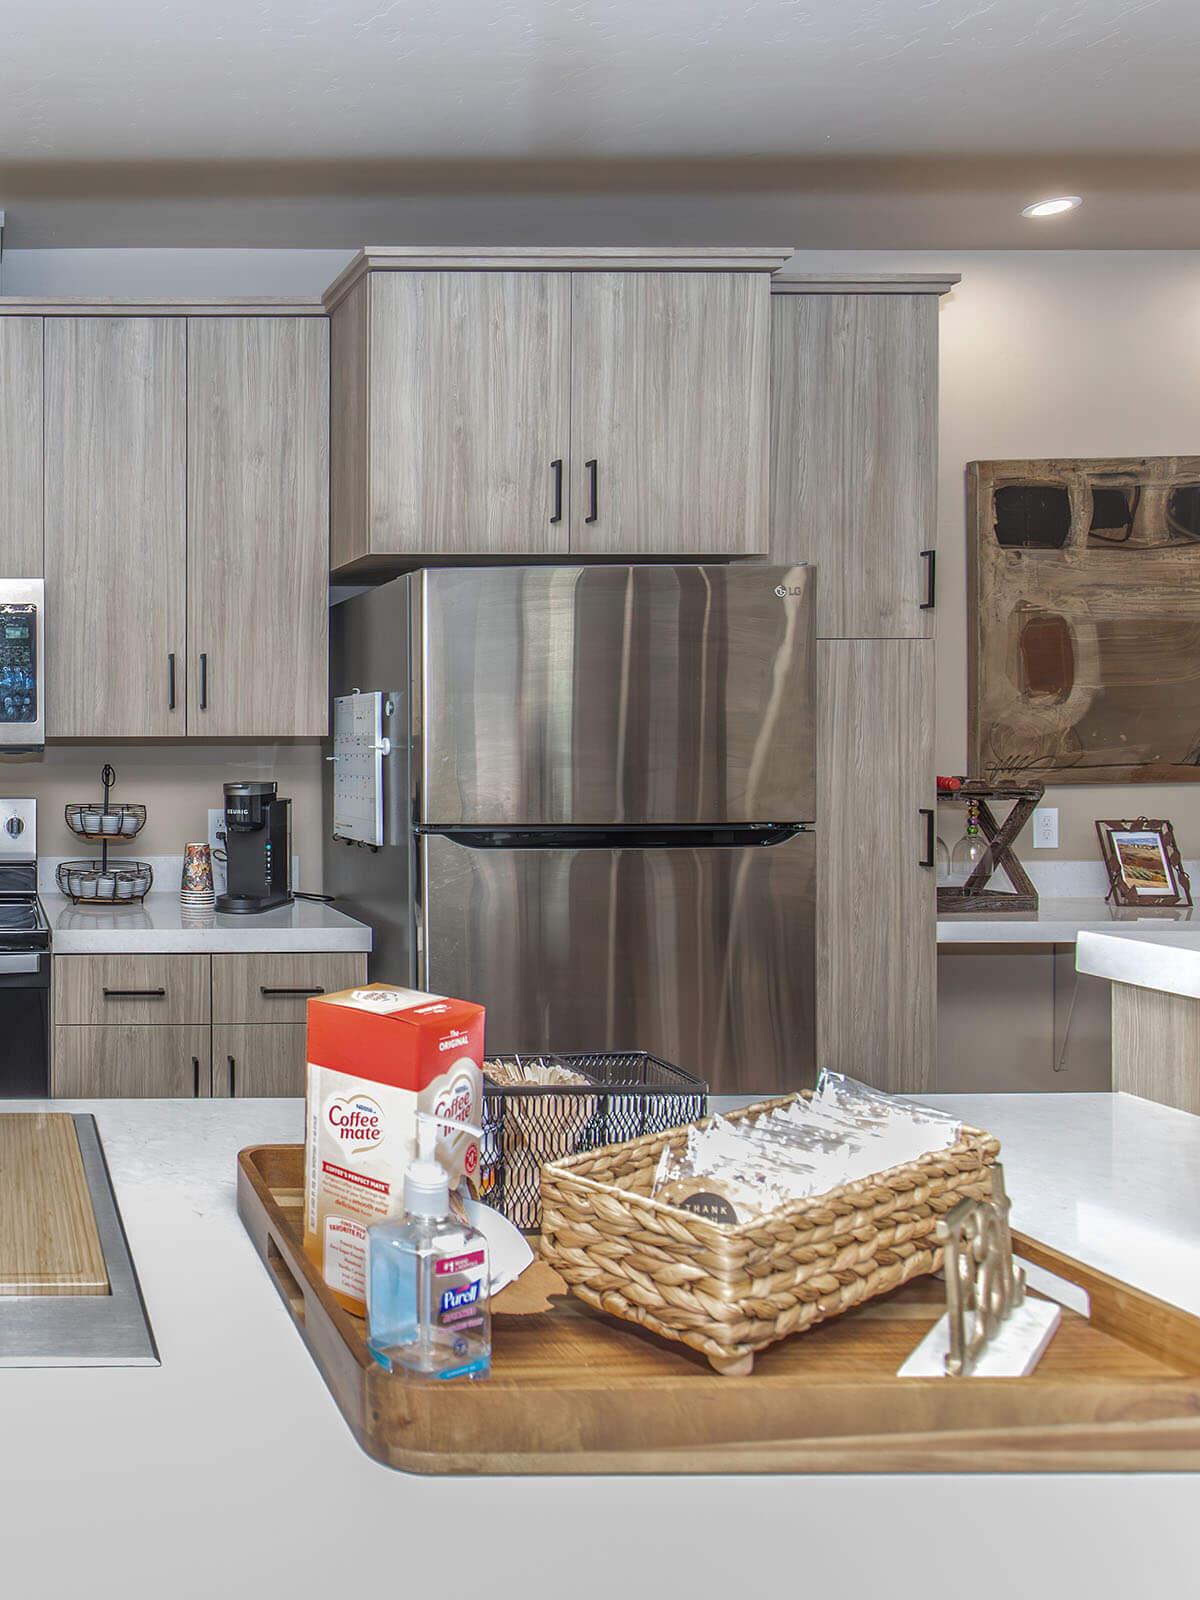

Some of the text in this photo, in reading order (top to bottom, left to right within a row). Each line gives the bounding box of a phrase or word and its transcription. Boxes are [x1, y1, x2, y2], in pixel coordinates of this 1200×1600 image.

[439, 1035, 469, 1051] ORIGINAL
[328, 1104, 379, 1127] Coffee
[340, 1127, 381, 1140] mate
[686, 1204, 727, 1215] THANK
